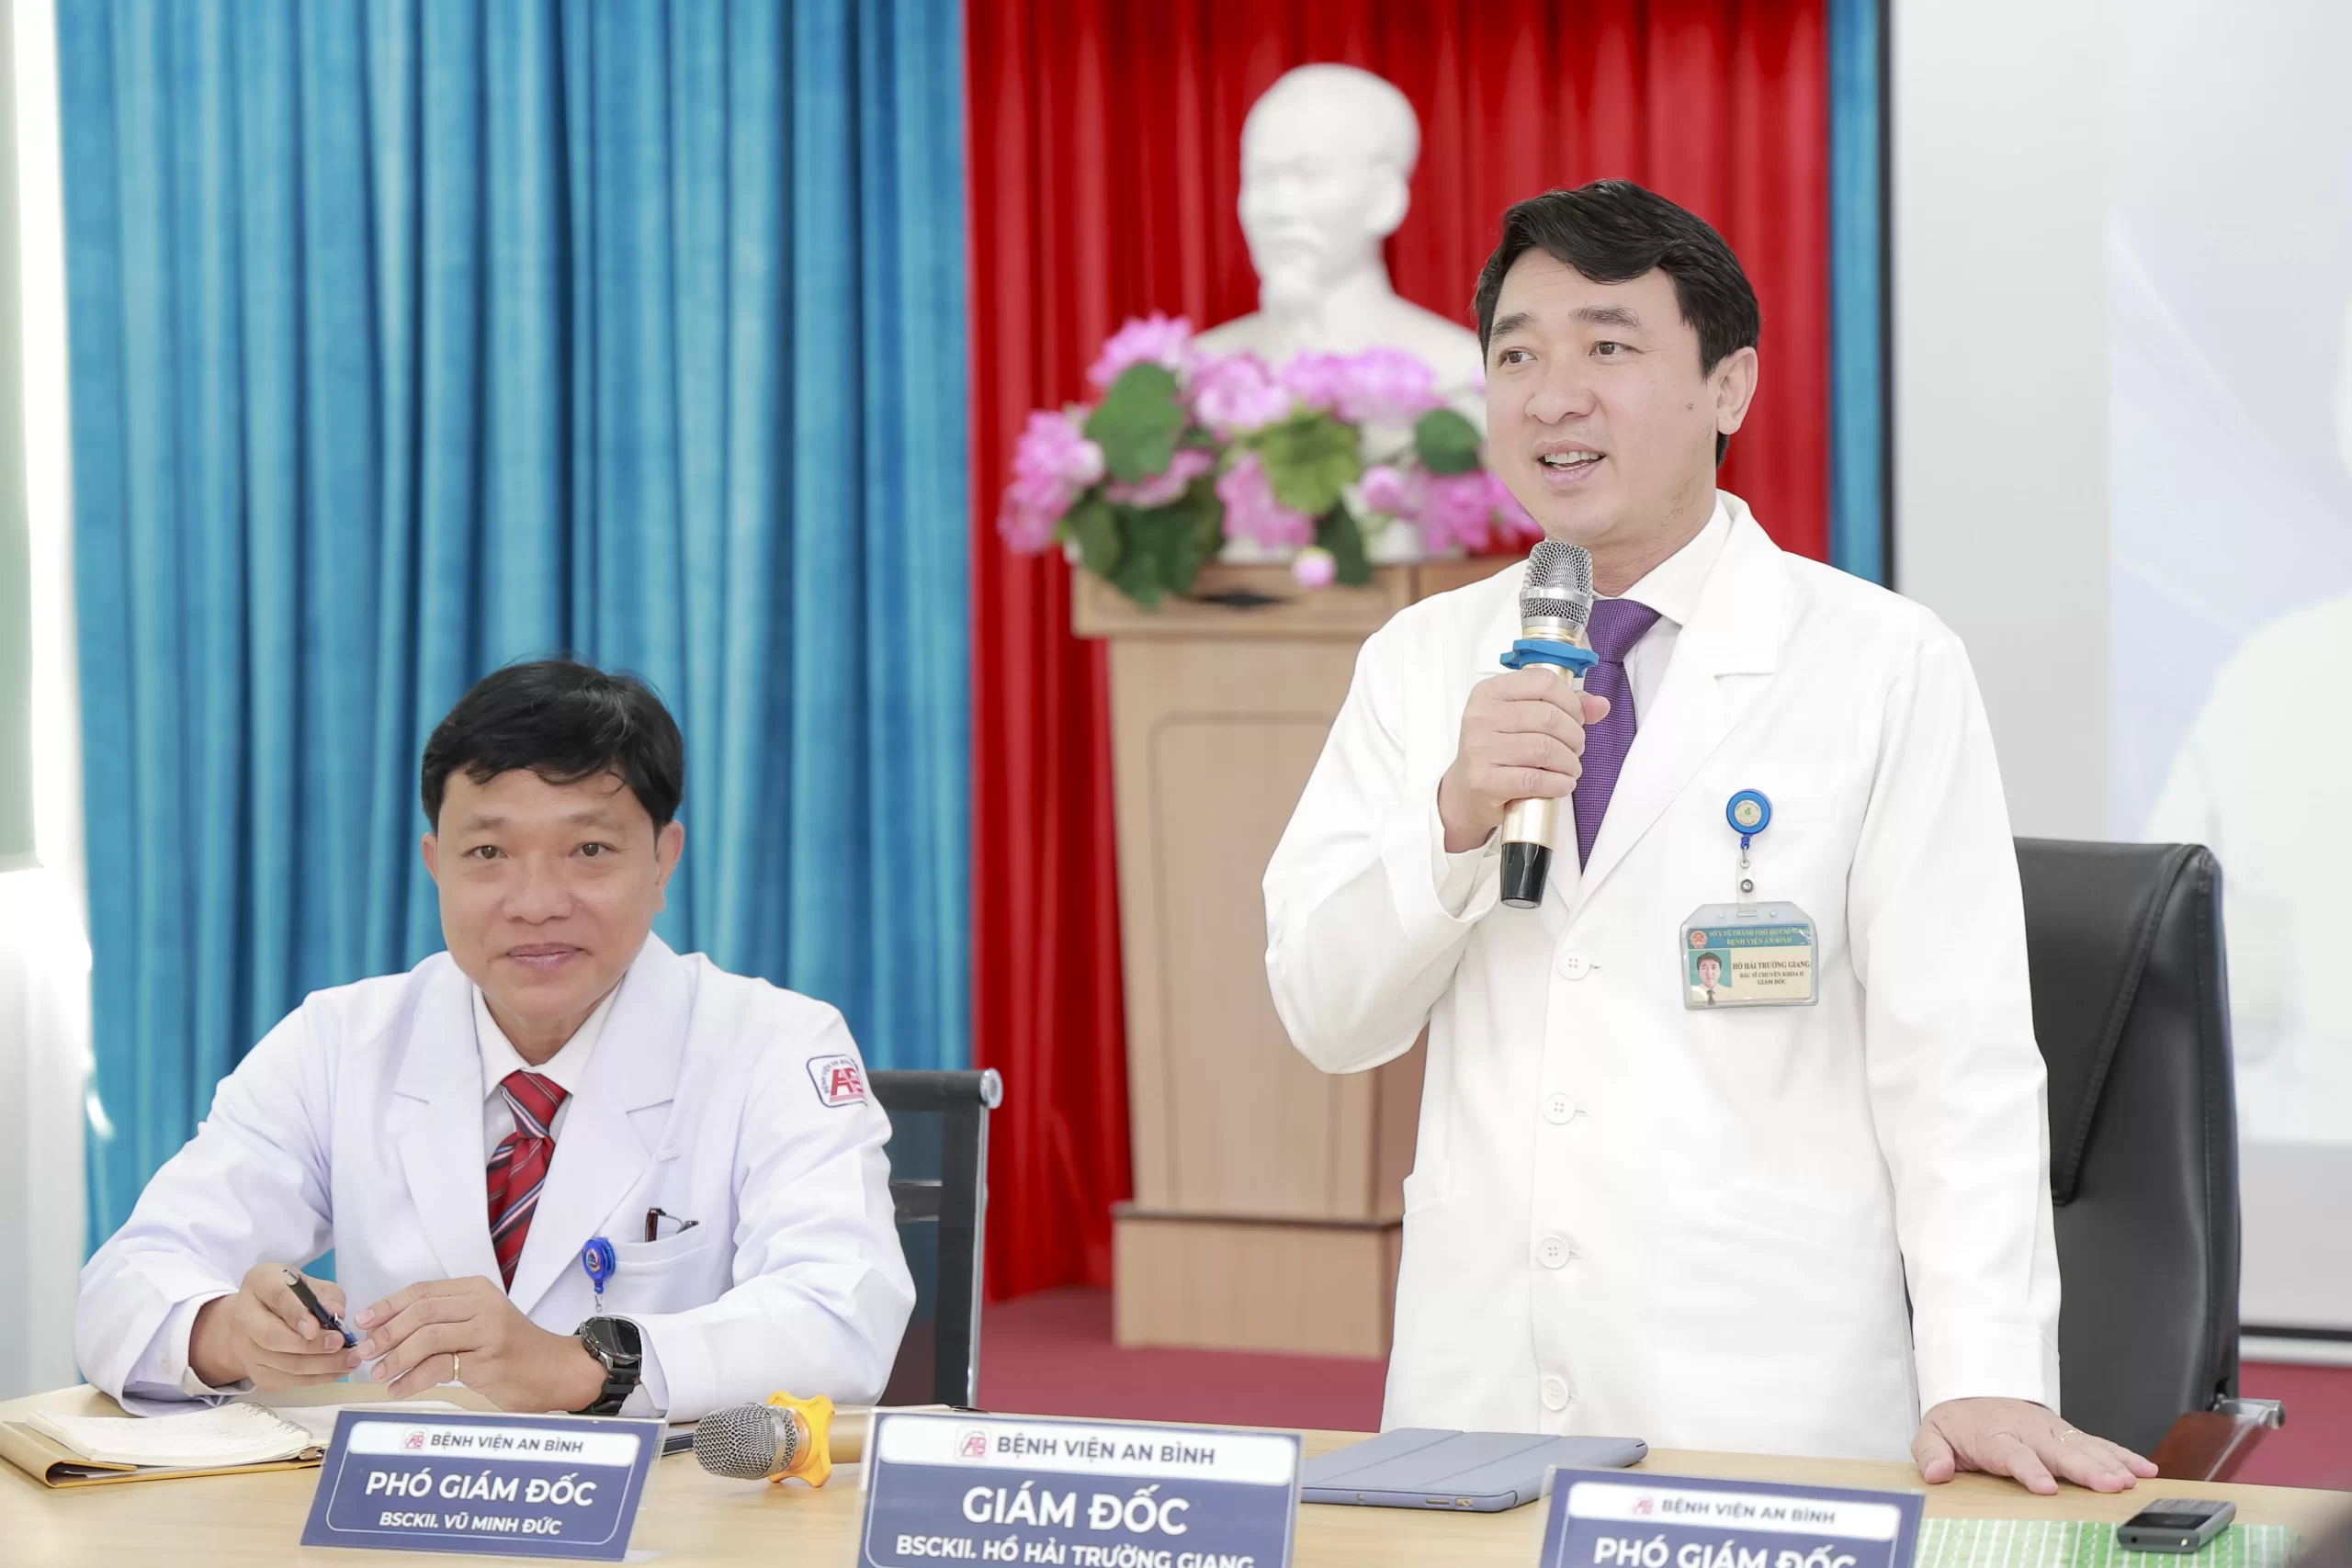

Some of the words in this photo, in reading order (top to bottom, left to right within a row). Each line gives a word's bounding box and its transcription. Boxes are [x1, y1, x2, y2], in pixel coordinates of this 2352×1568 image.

[1788, 960, 1810, 968] GIANG
[430, 1431, 474, 1450] BỆNH
[478, 1433, 514, 1451] VIỆN
[516, 1438, 540, 1450] AN
[544, 1437, 584, 1454] BÌNH
[997, 1432, 1057, 1460] BỆNH
[1065, 1436, 1114, 1463] VIỆN
[1123, 1444, 1153, 1461] AN
[1160, 1444, 1216, 1465] BÌNH
[365, 1467, 433, 1498] PHÓ
[438, 1470, 520, 1502] GIÁM
[525, 1472, 597, 1506] ĐỐC
[379, 1511, 439, 1529] BSCKII.
[444, 1511, 469, 1530] VŨ
[470, 1516, 519, 1533] MINH
[521, 1517, 563, 1536] ĐỨC
[962, 1480, 1077, 1529] GIÁM
[1088, 1483, 1191, 1536] ĐỐC
[1661, 1497, 1710, 1516] BỆNH
[1715, 1501, 1755, 1520] VIỆN
[1759, 1506, 1786, 1520] AN
[1791, 1506, 1837, 1525] BÌNH
[896, 1535, 978, 1560] BSCKII.
[982, 1534, 1020, 1562] HỒ
[1023, 1536, 1066, 1565] HẢI
[1071, 1543, 1172, 1568] TRƯỜNG
[1177, 1551, 1255, 1568] GIANG
[1593, 1534, 1670, 1568] PHÓ
[1677, 1540, 1770, 1568] GIÁM
